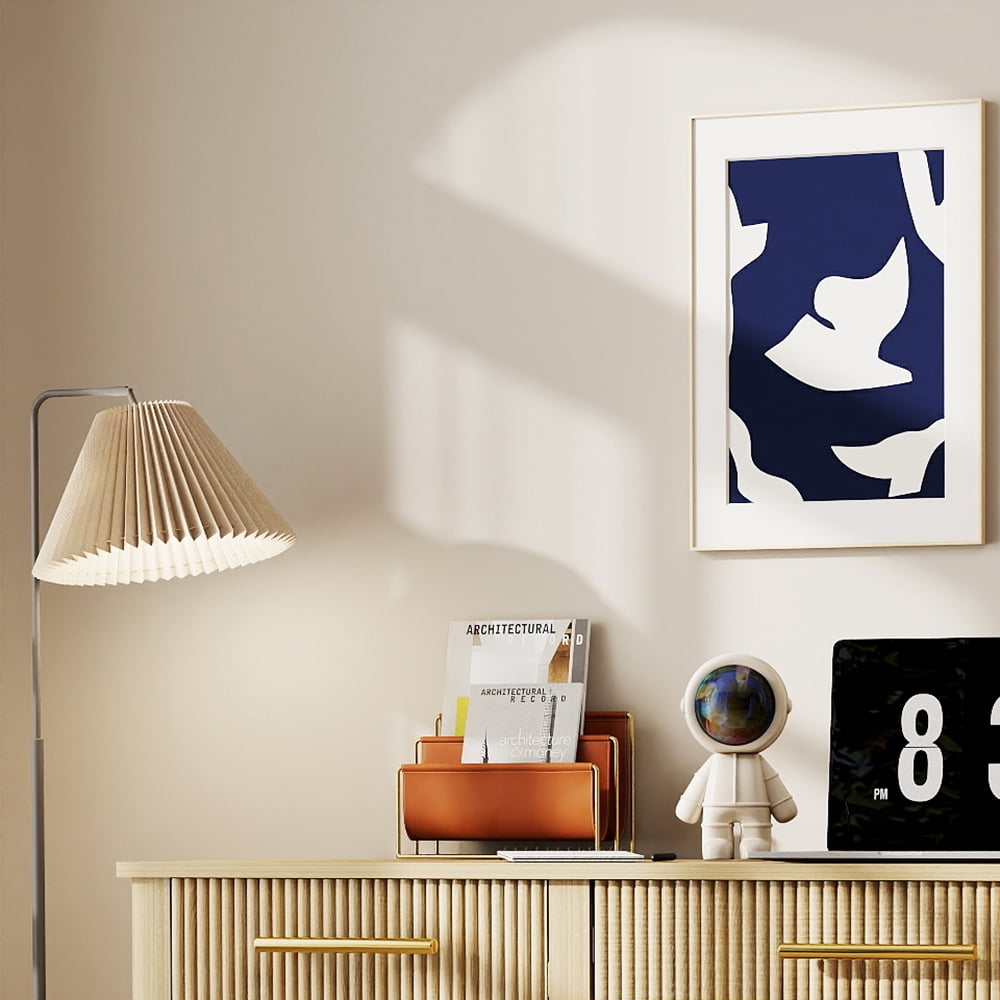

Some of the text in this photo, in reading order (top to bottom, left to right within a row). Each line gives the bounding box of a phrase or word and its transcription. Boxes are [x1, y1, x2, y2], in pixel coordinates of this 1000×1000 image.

[466, 623, 556, 635] ARCHITECTURAL
[481, 687, 547, 696] ARCHITECTURAL
[510, 695, 567, 703] RECORD
[500, 728, 572, 746] architecture
[898, 693, 943, 802] 8
[874, 788, 888, 800] PM
